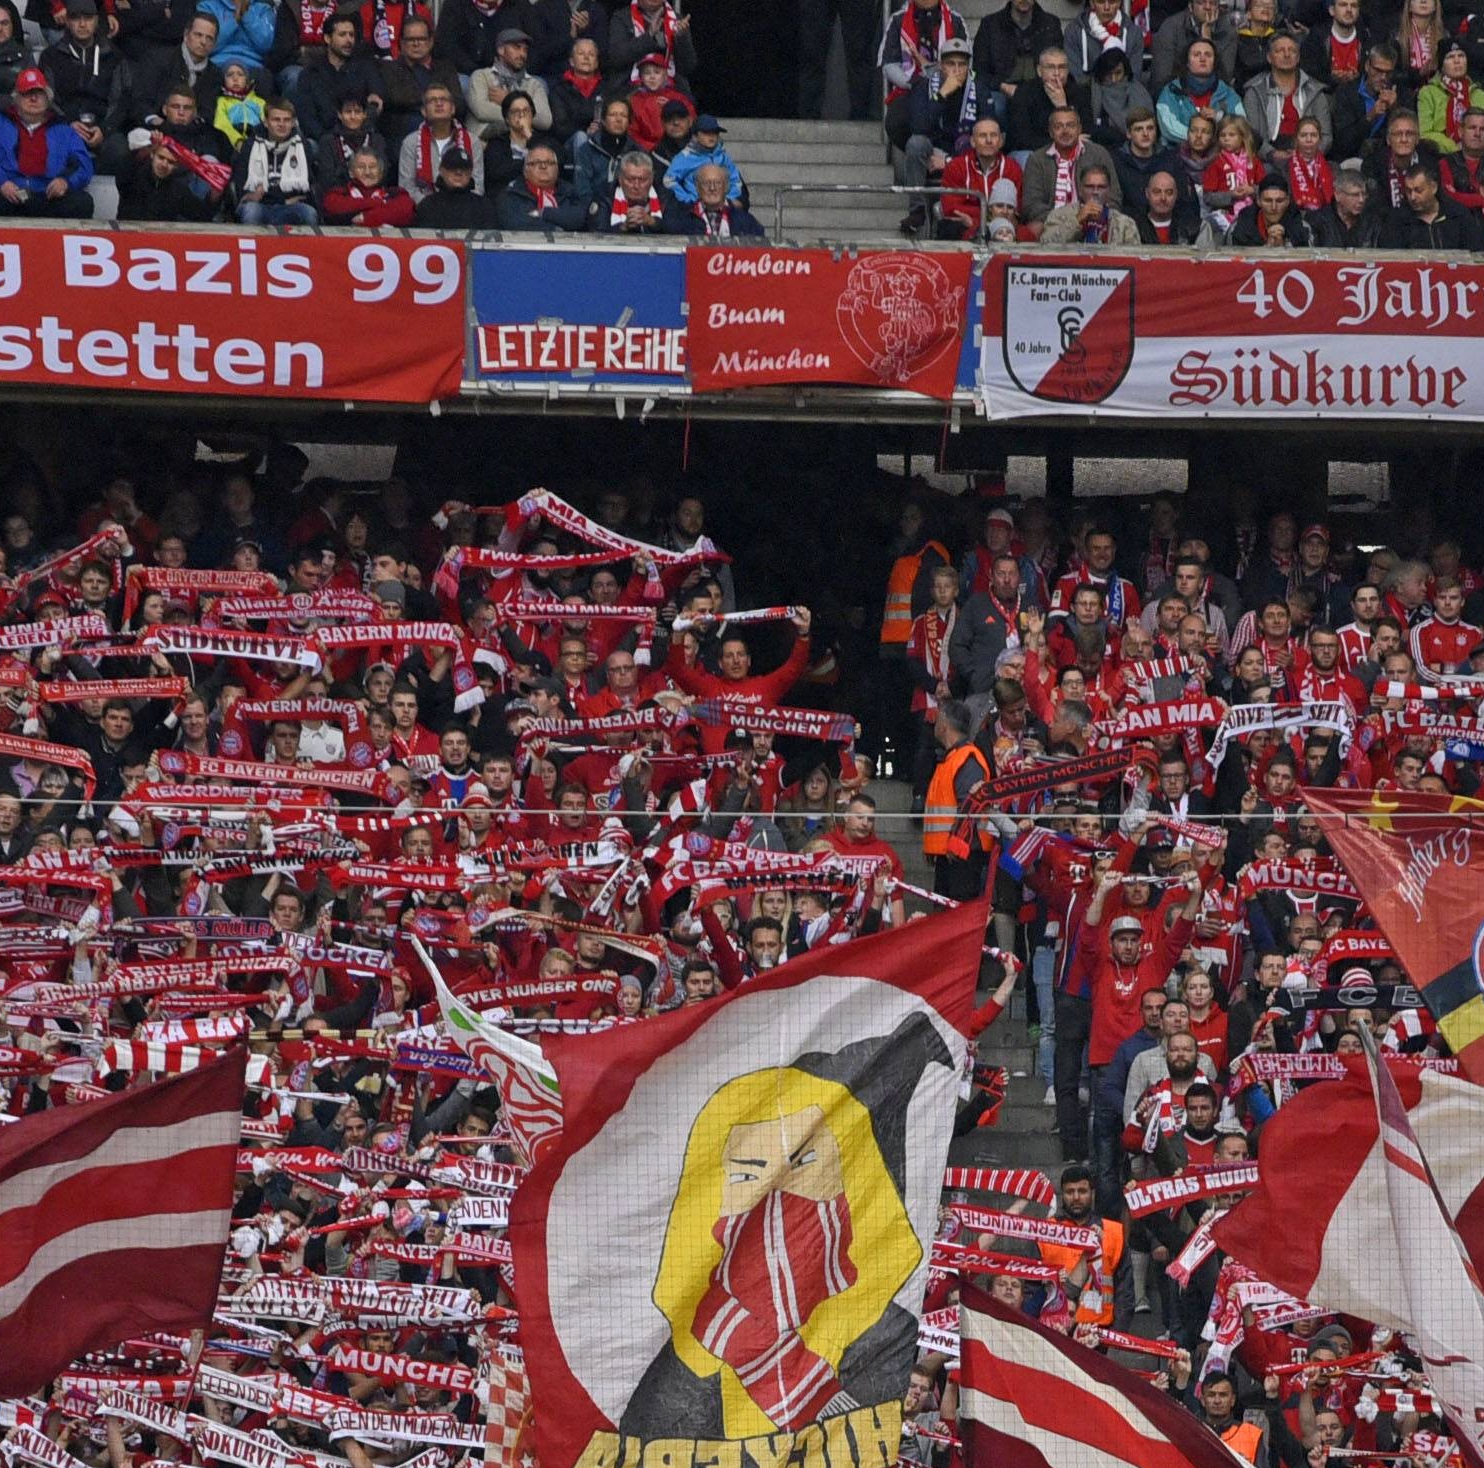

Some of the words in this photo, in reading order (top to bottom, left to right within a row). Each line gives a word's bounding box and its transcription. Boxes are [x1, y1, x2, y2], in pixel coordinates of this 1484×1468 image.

[63, 233, 314, 298] Bazis
[347, 243, 461, 305] 99
[707, 254, 811, 277] Cimbern
[1030, 289, 1082, 302] Fan-Club
[1236, 268, 1315, 319] 40
[707, 302, 786, 327] Buam
[478, 324, 598, 369] LETZTE
[1015, 343, 1026, 354] 40
[1028, 343, 1052, 354] Jahre
[712, 349, 830, 375] München
[1168, 347, 1467, 409] Südkurve
[219, 596, 288, 612] Allianz
[317, 596, 374, 611] Arena
[317, 626, 380, 644] BAYERN
[749, 705, 831, 723] BAYERN
[1116, 707, 1163, 733] SAN
[1169, 703, 1216, 724] MIA
[200, 758, 219, 774] FC
[223, 760, 284, 782] BAYERN
[287, 766, 376, 788] MÜNCHEN
[146, 784, 305, 801] REKORDMEISTER
[506, 979, 578, 997] NUMBER
[582, 978, 616, 995] ONE
[1125, 1176, 1200, 1211] ULTRAS
